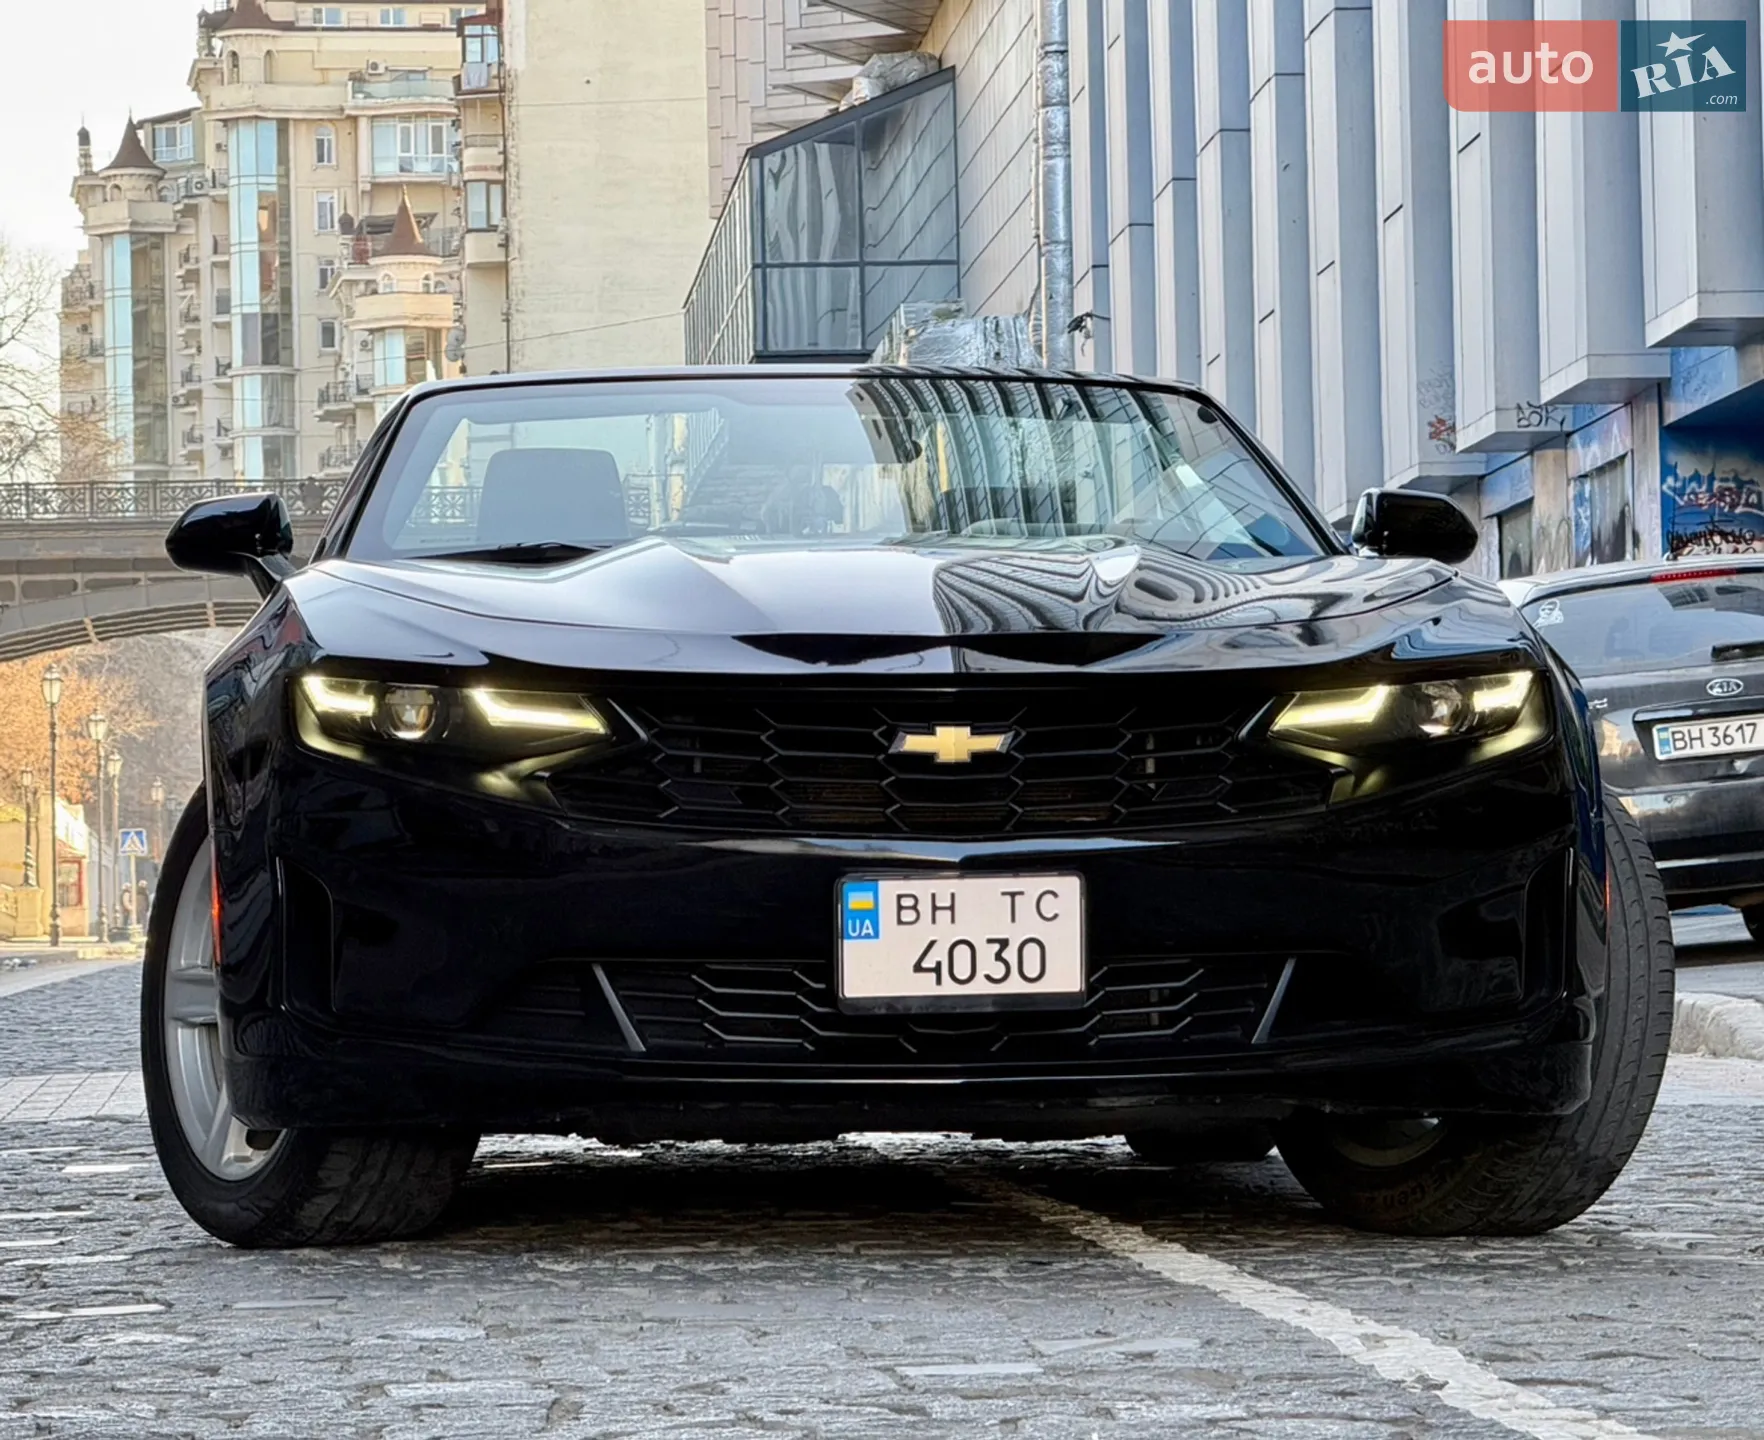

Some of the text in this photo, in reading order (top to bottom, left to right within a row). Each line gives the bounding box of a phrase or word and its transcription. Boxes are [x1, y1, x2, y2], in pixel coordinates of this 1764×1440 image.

[1711, 680, 1739, 694] KIA
[1671, 728, 1705, 752] BH
[1707, 722, 1758, 748] 3617
[895, 889, 1060, 926] BH TC
[848, 919, 875, 937] UA
[912, 937, 1047, 986] 4030
